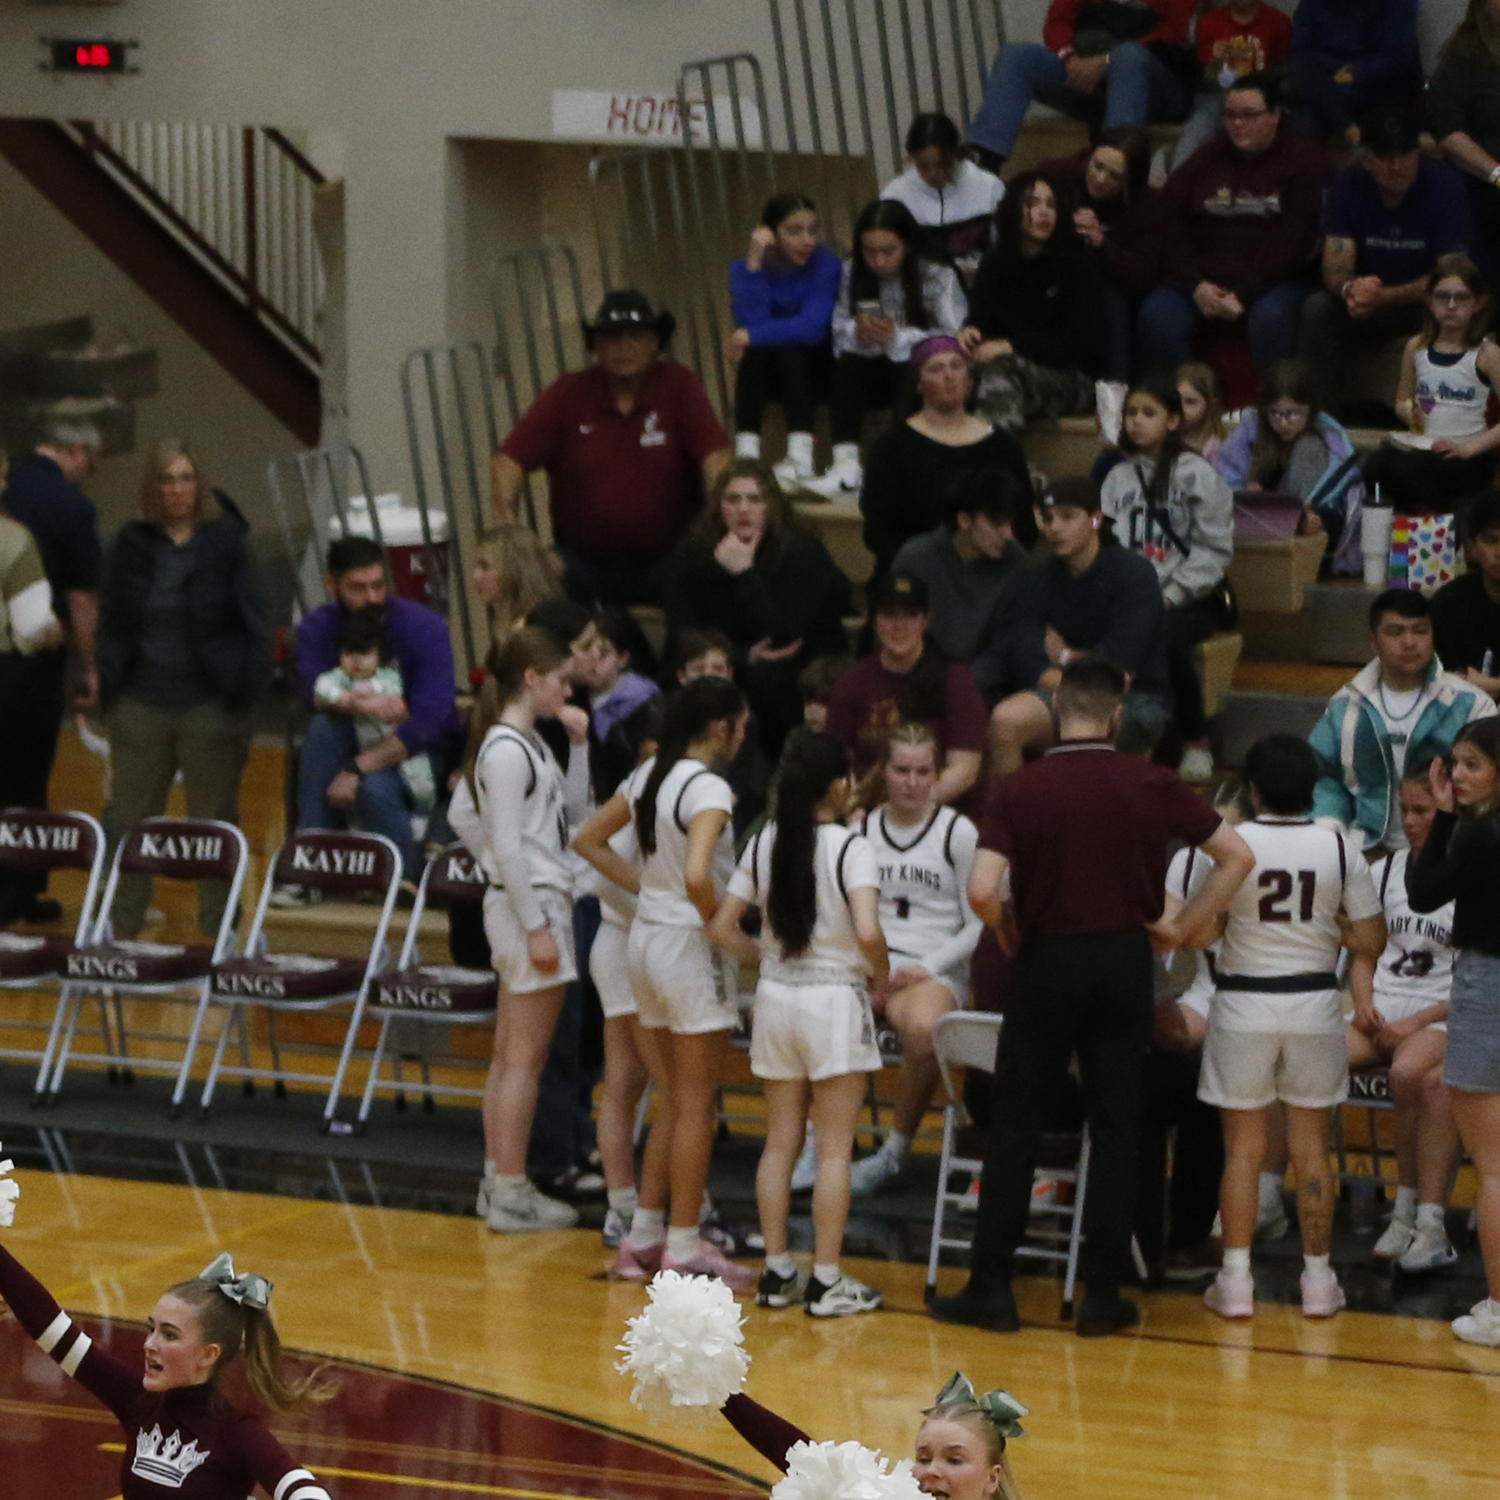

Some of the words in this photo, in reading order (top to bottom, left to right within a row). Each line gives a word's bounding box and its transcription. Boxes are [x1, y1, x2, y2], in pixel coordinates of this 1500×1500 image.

[140, 831, 222, 862] KAYHI
[293, 843, 376, 876] KAYHI
[1257, 868, 1317, 922] 21
[66, 955, 139, 981] KINGS
[216, 970, 285, 998] KINGS
[378, 983, 452, 1010] KINGS
